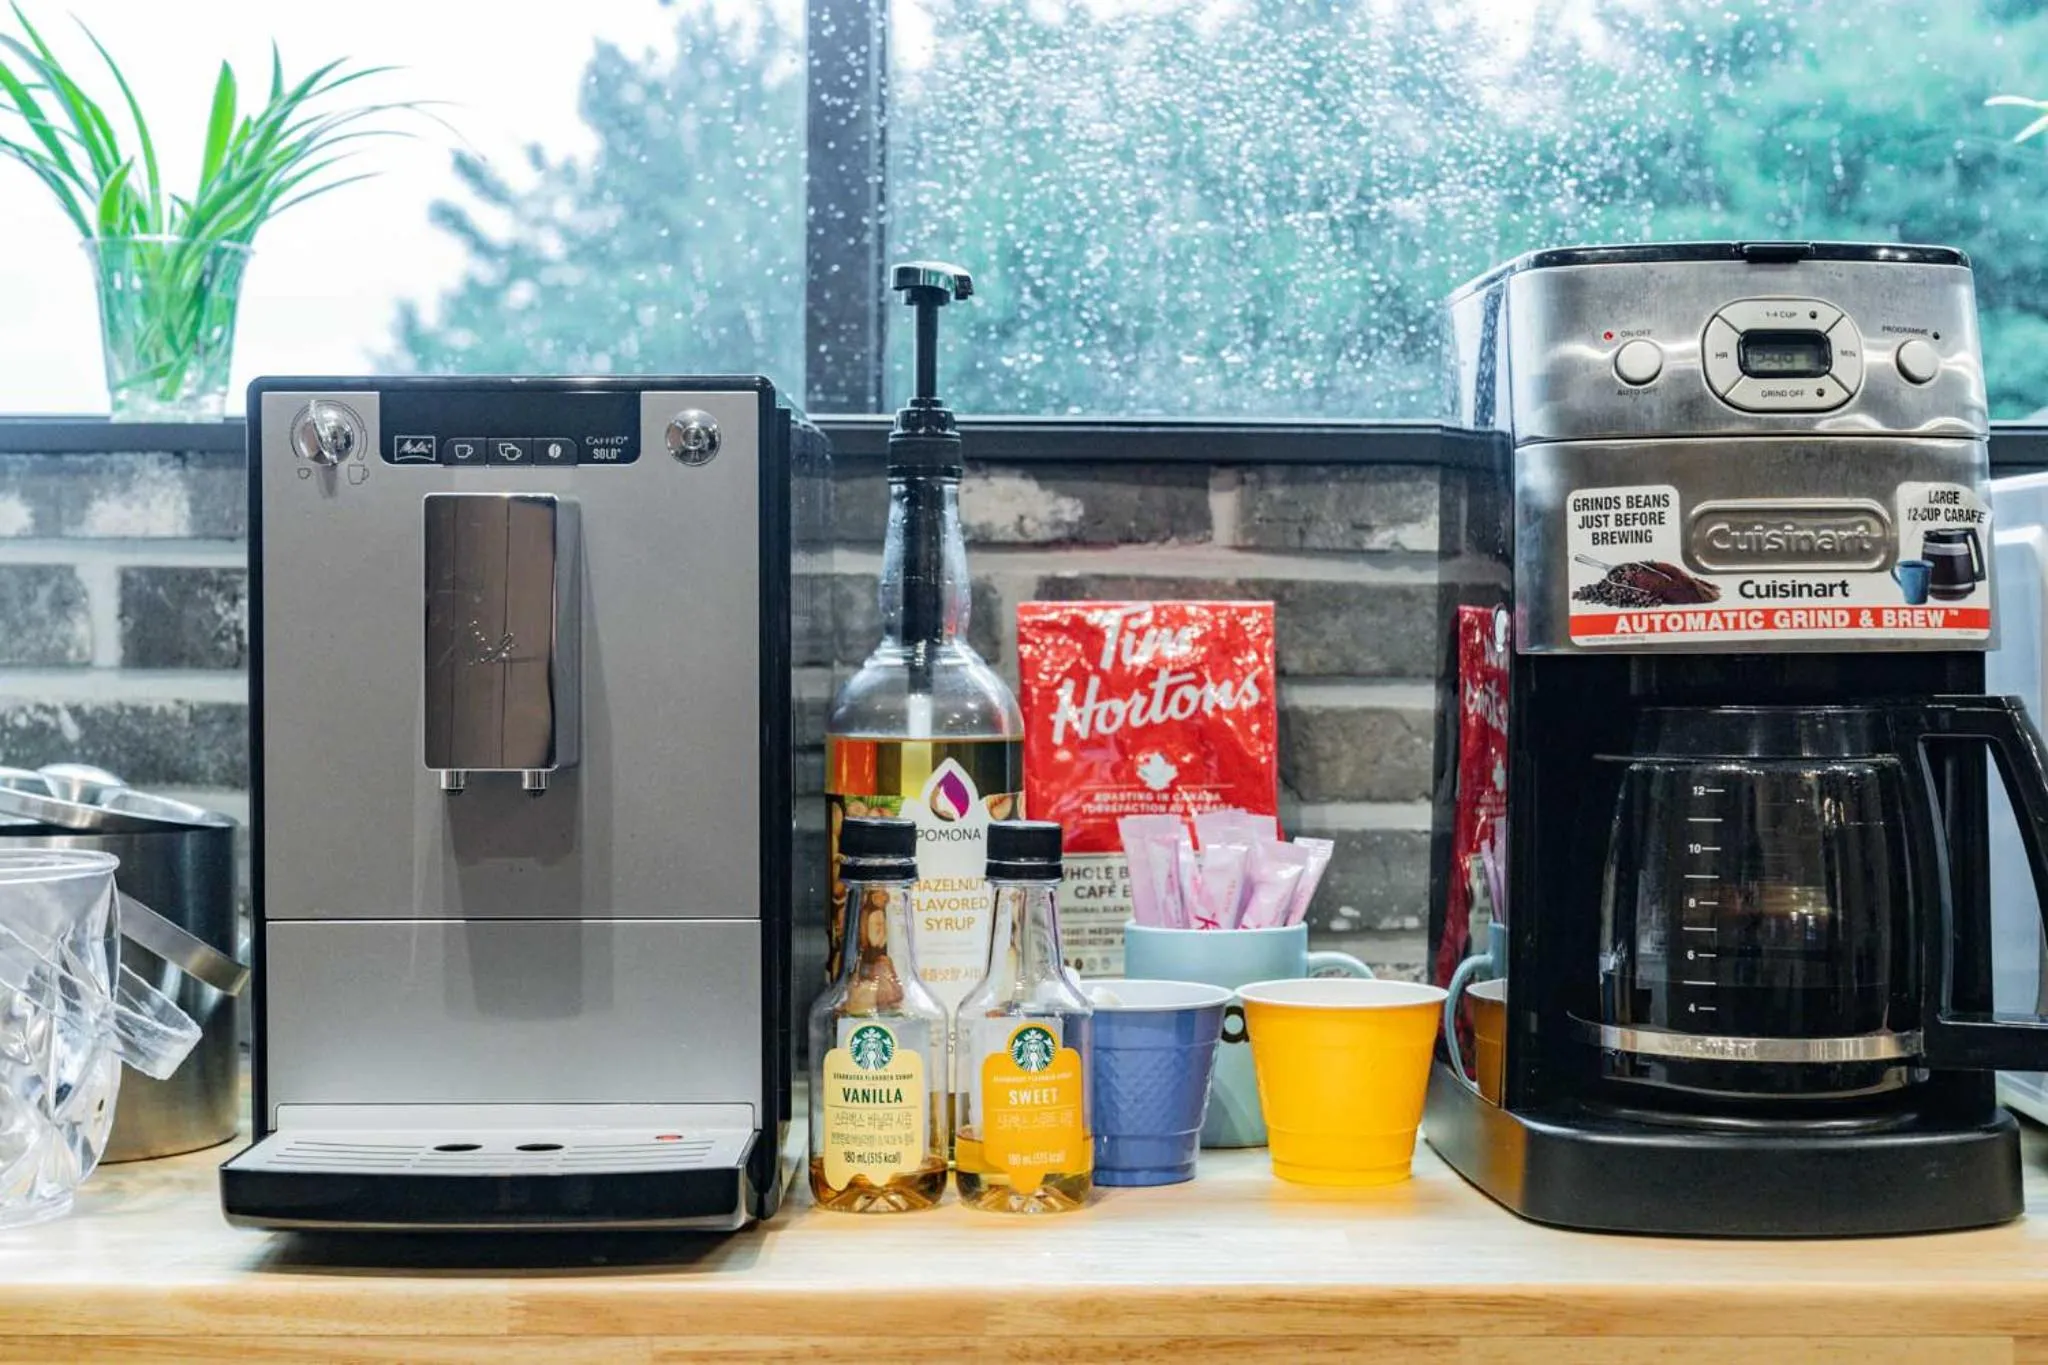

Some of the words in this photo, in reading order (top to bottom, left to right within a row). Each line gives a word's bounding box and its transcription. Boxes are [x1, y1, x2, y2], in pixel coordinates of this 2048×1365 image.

[1761, 390, 1787, 398] GRIND
[1789, 389, 1805, 397] OFF
[1573, 496, 1621, 512] GRINDS
[1626, 494, 1670, 509] BEANS
[1928, 490, 1960, 504] LARGE
[1578, 514, 1610, 529] JUST
[1615, 512, 1665, 527] BEFORE
[1907, 507, 1941, 521] 12-CUP
[1944, 508, 1985, 523] CARAFE
[1592, 530, 1653, 545] BREWING
[1705, 522, 1873, 552] Cuisinart
[1738, 579, 1850, 599] Cuisinart
[1614, 610, 1765, 634] AUTOMATIC
[1774, 610, 1850, 629] GRIND
[1859, 609, 1875, 629] &
[1050, 667, 1262, 746] Hortons
[1693, 786, 1705, 796] 12
[916, 828, 981, 842] POMONA
[1688, 844, 1701, 853] 10
[1074, 880, 1116, 899] CAFÉ
[1688, 898, 1695, 907] 8
[925, 916, 976, 931] SYRUP
[1687, 950, 1694, 960] 6
[1688, 1003, 1695, 1013] 4
[842, 1087, 903, 1104] VANILLA
[1008, 1088, 1059, 1105] SWEET
